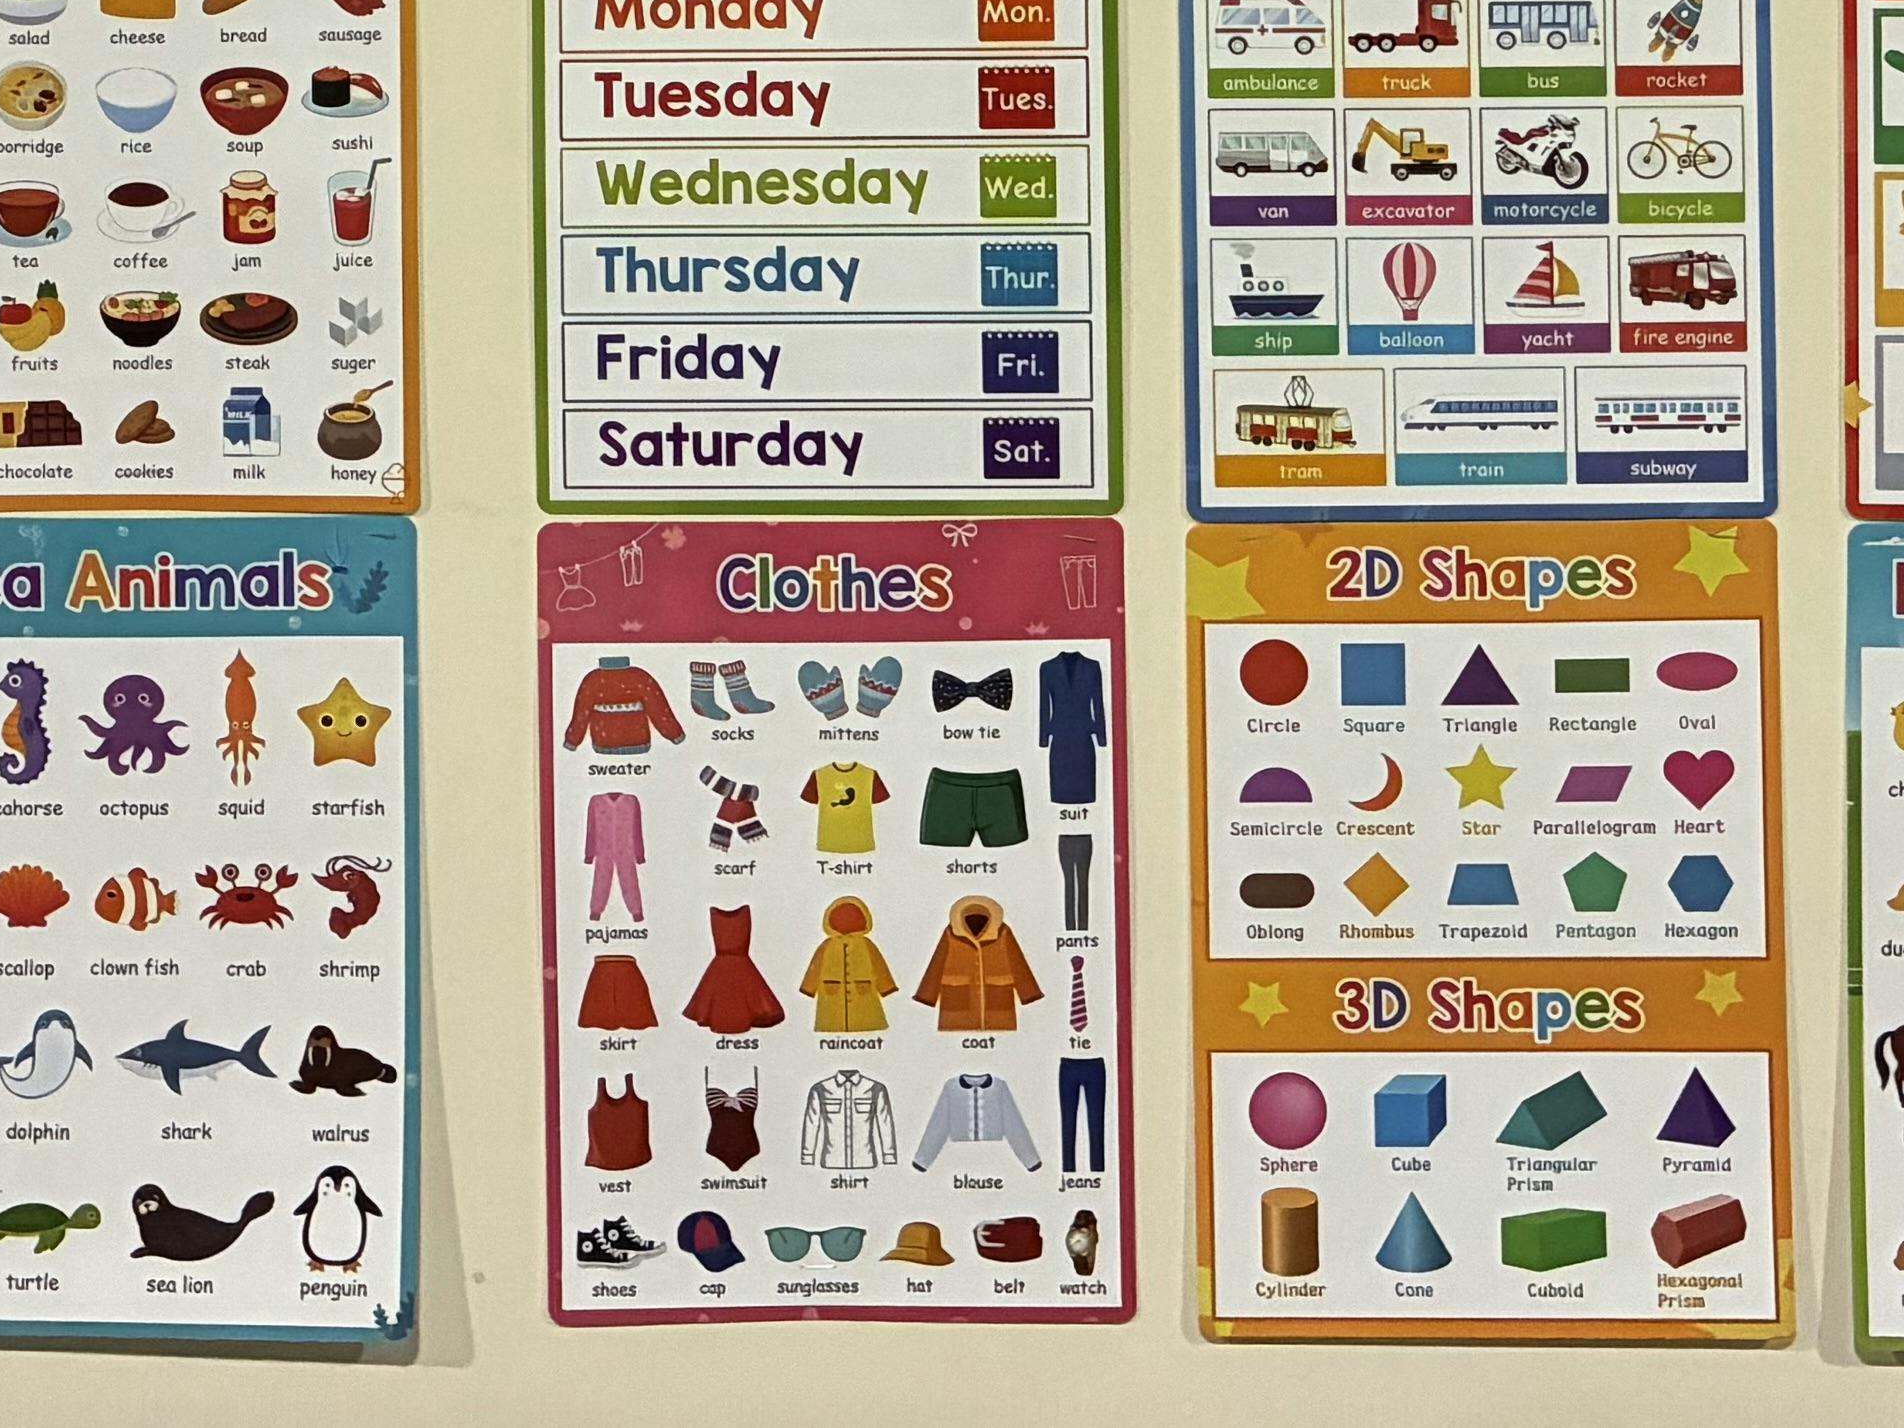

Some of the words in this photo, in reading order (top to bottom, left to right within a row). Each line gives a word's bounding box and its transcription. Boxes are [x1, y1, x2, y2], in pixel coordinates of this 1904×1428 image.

[983, 2, 1051, 23] Mon.
[594, 71, 831, 125] Tuesday
[982, 89, 1054, 111] Tues.
[596, 158, 928, 215] Wednesday
[985, 177, 1055, 199] Wed.
[1361, 202, 1455, 219] excavator
[1493, 201, 1597, 219] motorcycle
[596, 245, 860, 303] Thursday
[985, 266, 1056, 290] Thur.
[1632, 328, 1668, 345] fire
[1675, 330, 1734, 348] engine
[330, 356, 376, 373] suger
[596, 333, 780, 390] Friday
[998, 353, 1044, 378] Fri.
[599, 420, 863, 477] Saturday
[994, 441, 1051, 463] Sat.
[1630, 460, 1697, 479] subway
[65, 548, 331, 612] Animals
[716, 552, 953, 613] Clothes
[1325, 547, 1403, 601] 2D
[1419, 548, 1636, 611] Shapes
[1548, 716, 1637, 733] Rectangle
[1533, 819, 1657, 837] Parallelogram
[817, 860, 873, 876] T-shirt
[1332, 979, 1410, 1033] 3D
[1427, 977, 1646, 1043] Shapes
[5, 1123, 71, 1142] dolphin
[1662, 1157, 1732, 1174] Pyramid
[299, 1279, 368, 1300] penguin
[776, 1279, 860, 1297] sunglasses
